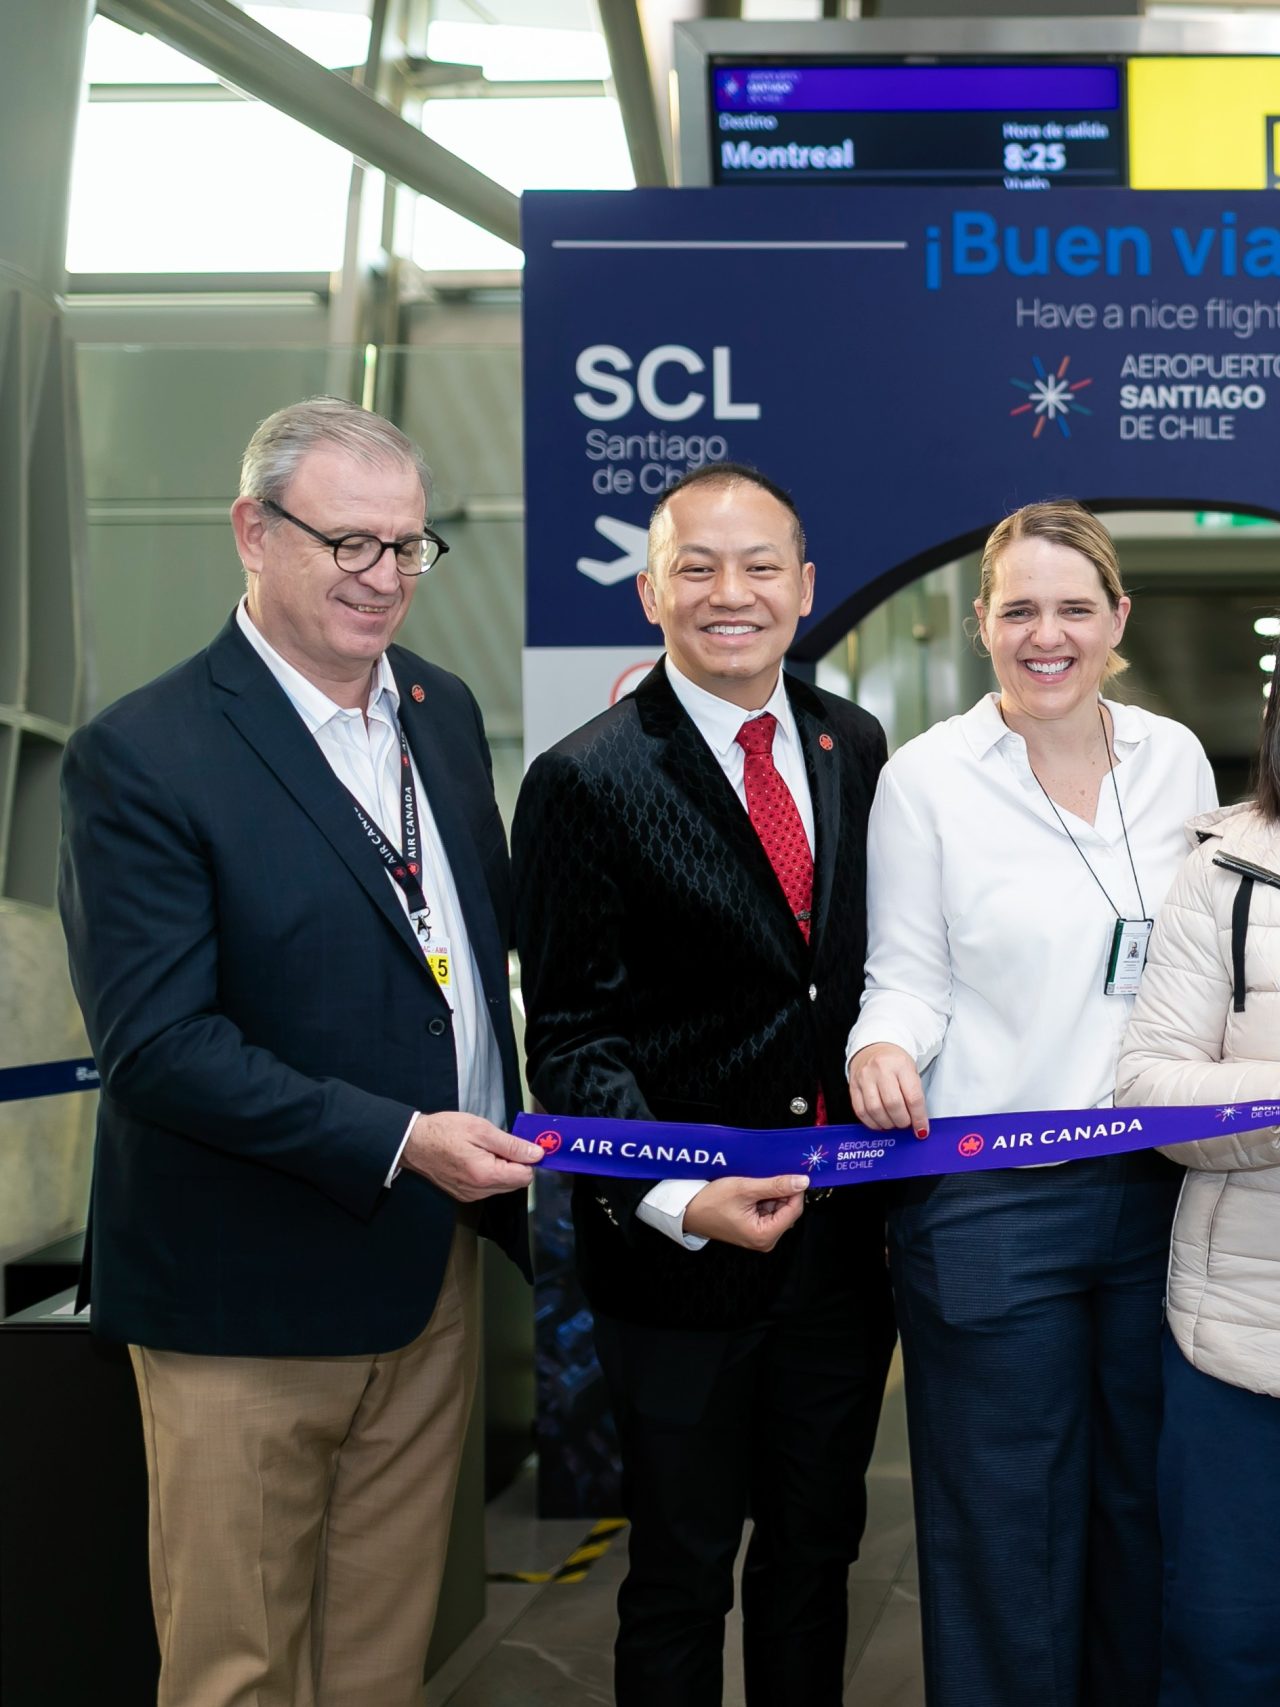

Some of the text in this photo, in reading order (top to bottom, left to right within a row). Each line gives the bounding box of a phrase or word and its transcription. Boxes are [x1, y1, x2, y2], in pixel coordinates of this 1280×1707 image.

[719, 112, 778, 131] Destino
[1003, 120, 1109, 139] Hora de salida
[720, 138, 854, 169] Montreal
[1003, 143, 1067, 171] 8:25
[925, 210, 1152, 290] ¡Buen
[1016, 298, 1098, 329] Have
[1103, 305, 1124, 330] a
[1130, 298, 1199, 330] nice
[573, 344, 762, 422] SCL
[1119, 385, 1267, 410] SANTIAGO
[1120, 416, 1235, 440] DE CHILE
[585, 428, 729, 468] Santiago
[592, 464, 634, 495] de
[404, 786, 417, 858] AIR CANADA
[379, 843, 397, 864] AIR
[438, 958, 448, 978] 5
[1251, 1111, 1263, 1119] DE
[838, 1139, 896, 1151] AEROPUERTO
[992, 1117, 1144, 1150] AIR CANADA
[570, 1137, 728, 1167] AIR CANADA
[836, 1159, 874, 1171] DE CHILE
[837, 1149, 885, 1161] SANTIAGO
